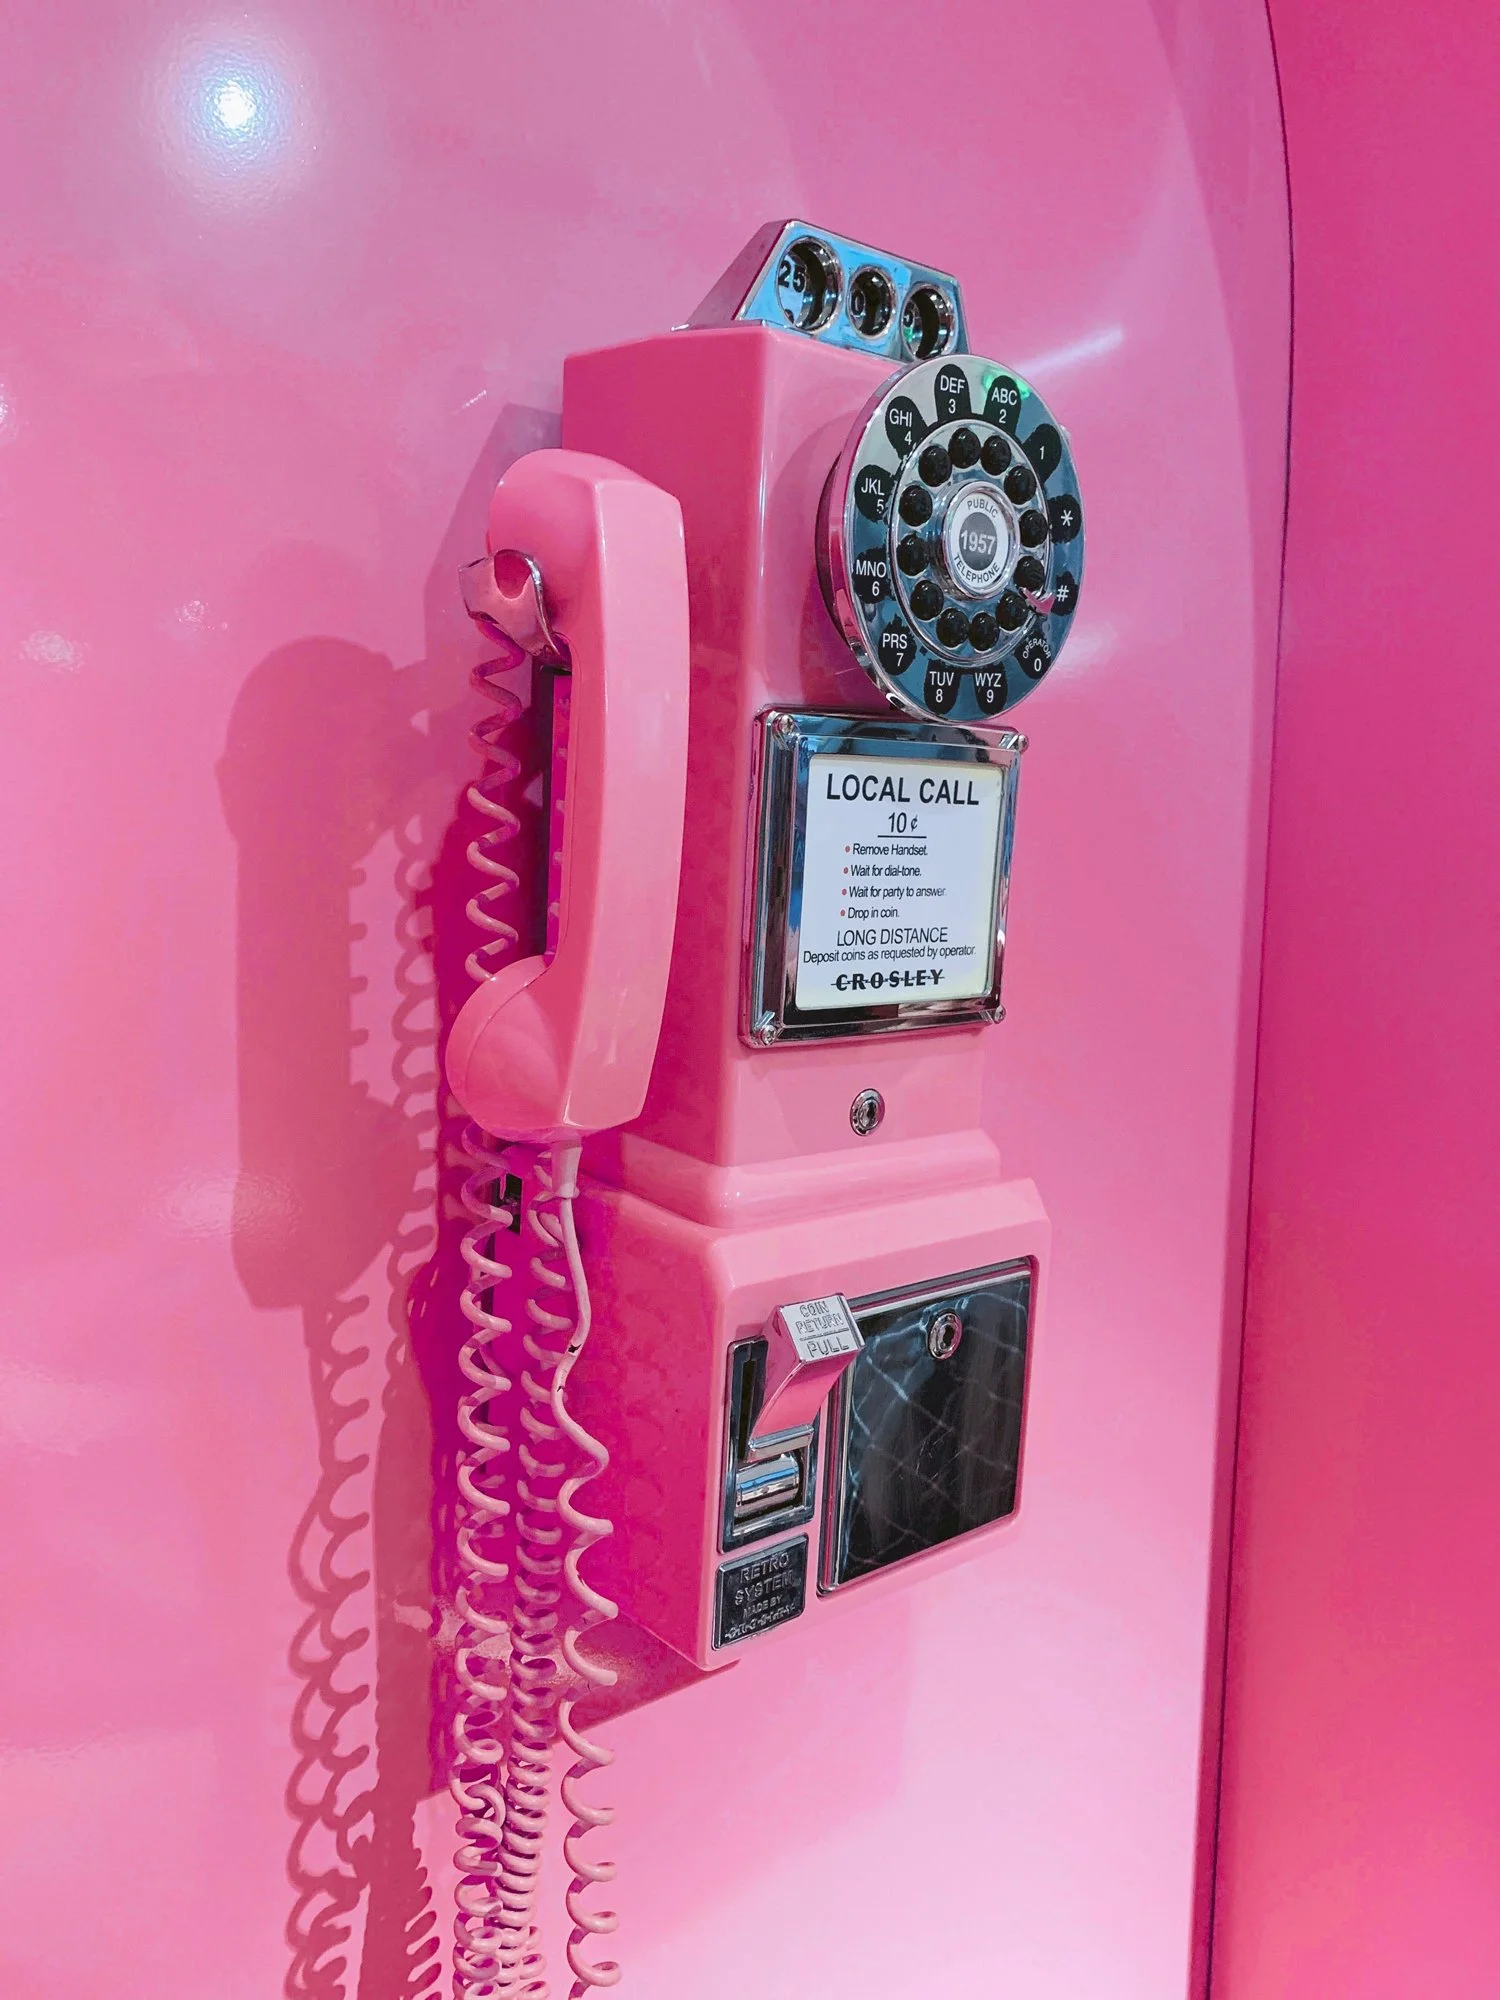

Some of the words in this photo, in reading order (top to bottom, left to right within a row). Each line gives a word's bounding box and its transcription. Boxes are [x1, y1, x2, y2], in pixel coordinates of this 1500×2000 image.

[778, 259, 806, 292] 25
[940, 375, 965, 394] DEF
[991, 387, 1018, 406] ABC
[948, 399, 956, 414] 3
[889, 408, 913, 426] GHI
[999, 409, 1007, 424] 2
[904, 430, 912, 446] 4
[1039, 445, 1045, 460] 1
[861, 477, 885, 496] JKL
[876, 499, 885, 514] 5
[966, 498, 998, 518] PUBLIC
[960, 529, 996, 555] 1957
[856, 560, 886, 577] MNO
[953, 553, 1000, 583] TELEPHONE
[871, 581, 880, 596] 6
[1056, 585, 1070, 602] #
[882, 633, 907, 650] PRS
[1022, 638, 1052, 659] OPERATOR
[897, 653, 904, 667] 7
[1034, 658, 1042, 672] 0
[929, 671, 954, 687] TUV
[975, 672, 1002, 688] WYZ
[936, 688, 943, 703] 8
[987, 689, 994, 704] 9
[826, 773, 911, 803] LOCAL
[919, 778, 980, 806] CALL
[888, 812, 907, 833] 10
[852, 843, 889, 856] Remove
[891, 843, 928, 856] Handset.
[850, 864, 870, 877] Wait
[872, 864, 884, 877] for
[884, 864, 922, 877] dial-tone.
[849, 886, 869, 898] Wait
[870, 885, 881, 898] for
[883, 886, 904, 900] party
[906, 886, 914, 897] to
[847, 906, 869, 921] Drop
[871, 906, 879, 918] in
[880, 906, 900, 918] coin.
[836, 929, 876, 946] LONG
[880, 926, 948, 944] DISTANCE
[803, 950, 840, 965] Deposit
[841, 950, 866, 961] coins
[867, 950, 879, 960] as
[880, 947, 926, 961] requested
[926, 945, 939, 958] by
[835, 968, 943, 991] CROSLEY
[799, 1300, 830, 1318] COIN
[795, 1312, 845, 1335] RETURN
[806, 1337, 850, 1358] PULL
[740, 1551, 790, 1583] RETRO
[734, 1569, 795, 1606] SYSTEM
[769, 1594, 783, 1607] BY
